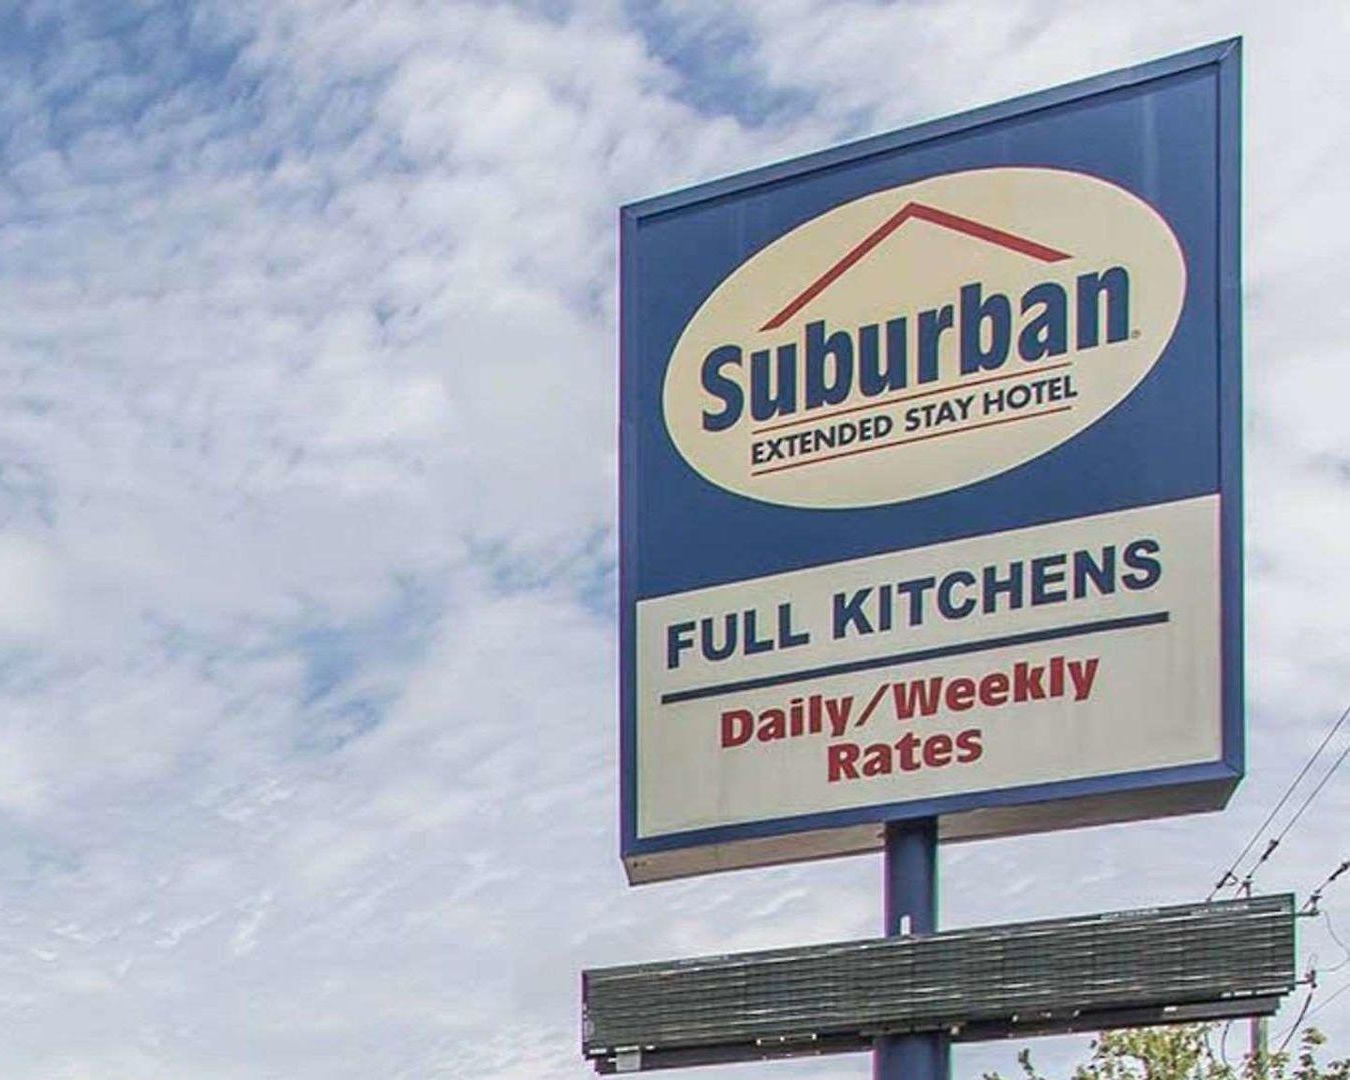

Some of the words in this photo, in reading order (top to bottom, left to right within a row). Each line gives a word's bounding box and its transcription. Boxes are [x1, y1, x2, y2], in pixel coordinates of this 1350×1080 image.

[701, 264, 1130, 432] Suburban
[752, 415, 893, 466] EXTENDED
[904, 395, 977, 432] STAY
[983, 375, 1078, 417] HOTEL
[667, 603, 810, 669] FULL
[832, 539, 1162, 640] KITCHENS
[720, 656, 1100, 748] Daily/Weekly
[827, 728, 983, 783] Rates
